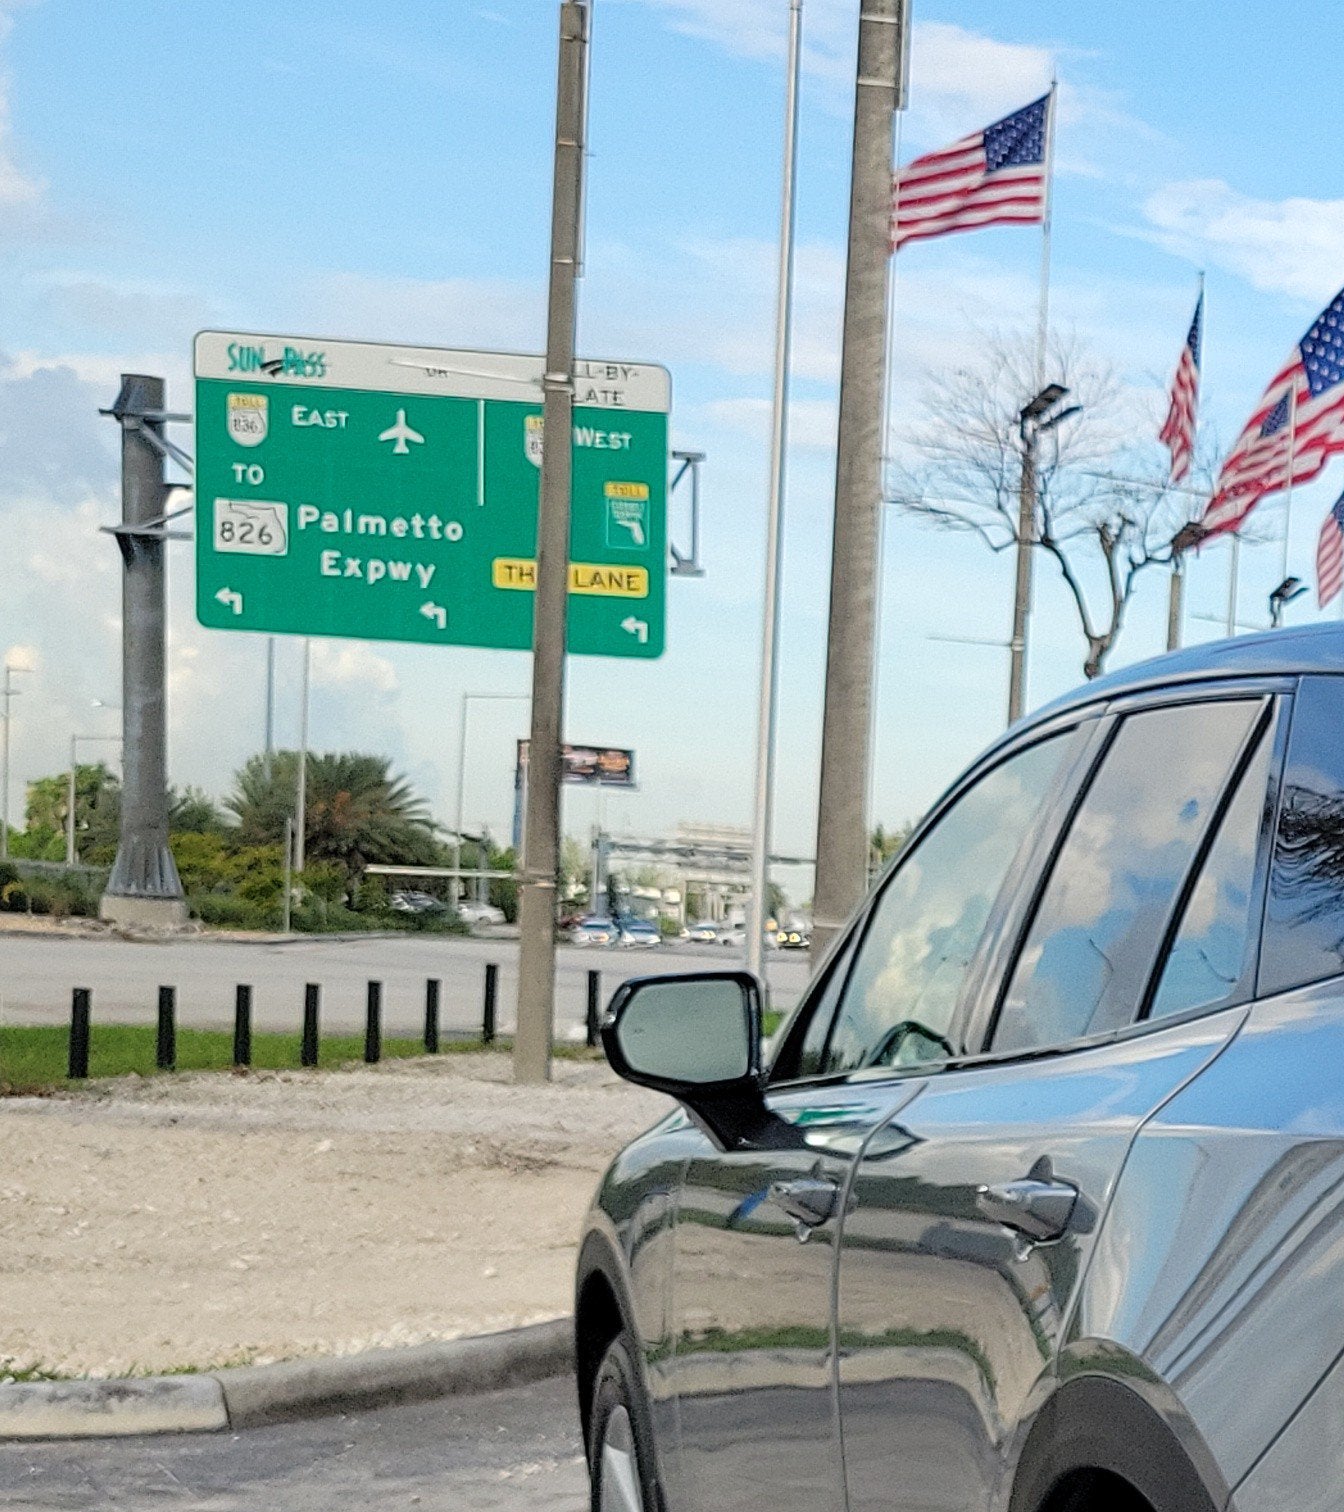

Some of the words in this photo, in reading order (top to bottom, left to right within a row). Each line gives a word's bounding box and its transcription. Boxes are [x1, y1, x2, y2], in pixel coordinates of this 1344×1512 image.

[291, 404, 349, 429] EAST
[573, 425, 632, 451] WEST
[231, 462, 265, 486] TO
[219, 520, 273, 546] 826
[297, 503, 464, 542] Palmetto
[320, 549, 436, 589] Expwy
[573, 568, 642, 592] LANE
